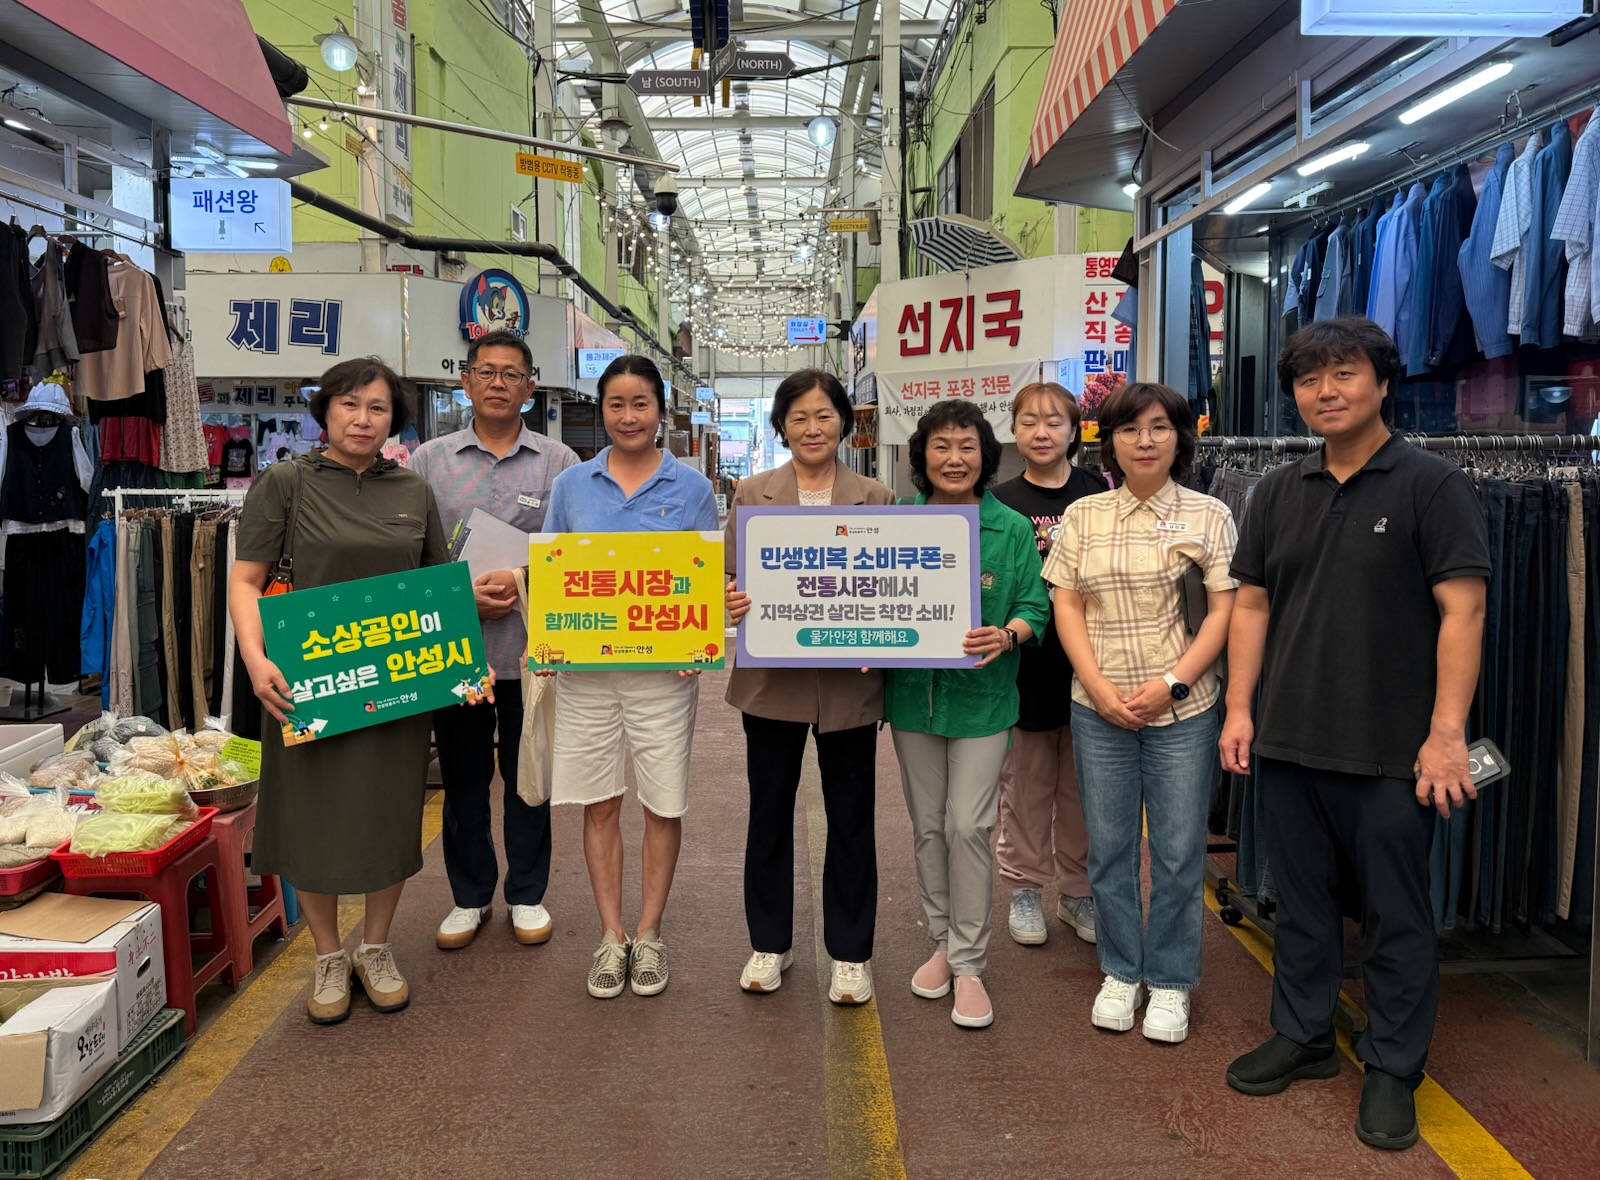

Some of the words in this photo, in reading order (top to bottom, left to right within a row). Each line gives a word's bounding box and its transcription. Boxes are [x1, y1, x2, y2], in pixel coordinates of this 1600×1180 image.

[737, 58, 782, 71] (NORTH)
[641, 77, 652, 88] 남
[655, 76, 701, 88] (SOUTH)
[519, 158, 540, 173] 방범용
[542, 161, 558, 174] CCTV
[560, 164, 579, 179] 작동중
[192, 190, 258, 213] 패션왕
[226, 298, 342, 356] 제리
[897, 289, 1023, 357] 선지국
[217, 392, 230, 405] 과
[232, 385, 276, 406] 제리
[901, 381, 941, 400] 선지국
[946, 378, 976, 398] 포장
[981, 375, 1011, 396] 전문
[884, 405, 901, 417] 회사,
[760, 546, 848, 570] 민생회복
[853, 546, 956, 570] 소비쿠폰은
[563, 570, 691, 597] 전통시장과
[796, 576, 918, 598] 전통시장에서
[545, 612, 617, 631] 함께하는
[627, 604, 708, 631] 안성시
[760, 604, 824, 621] 지역상권
[827, 604, 876, 621] 살리는
[878, 604, 913, 621] 착한
[915, 604, 955, 621] 소비!
[301, 610, 442, 661] 소상공인이
[809, 630, 858, 645] 물가안정
[860, 630, 908, 644] 함께해요
[636, 645, 653, 654] 안성
[291, 664, 379, 704] 살고싶은
[386, 637, 473, 682] 안성시
[400, 692, 417, 703] 안성
